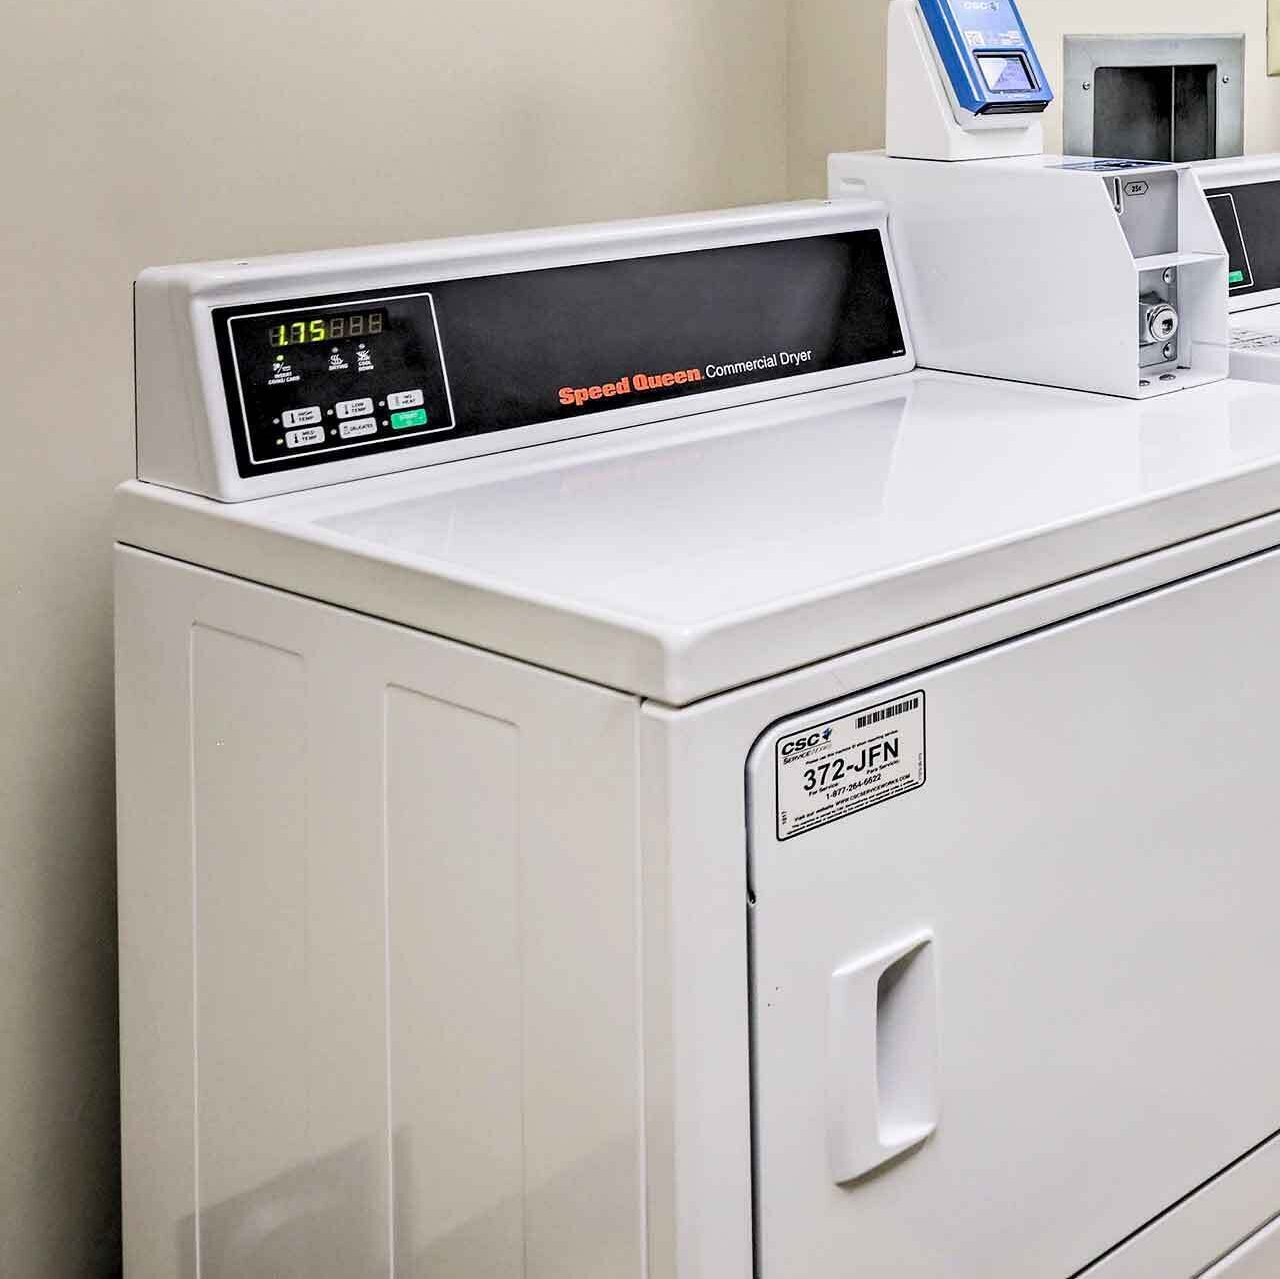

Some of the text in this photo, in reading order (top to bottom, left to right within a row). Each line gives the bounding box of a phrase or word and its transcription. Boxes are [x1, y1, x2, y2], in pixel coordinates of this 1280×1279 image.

[559, 350, 811, 405] Speed Queen Commercial Dryer
[782, 733, 819, 756] CSC
[804, 738, 899, 791] 372-JFN
